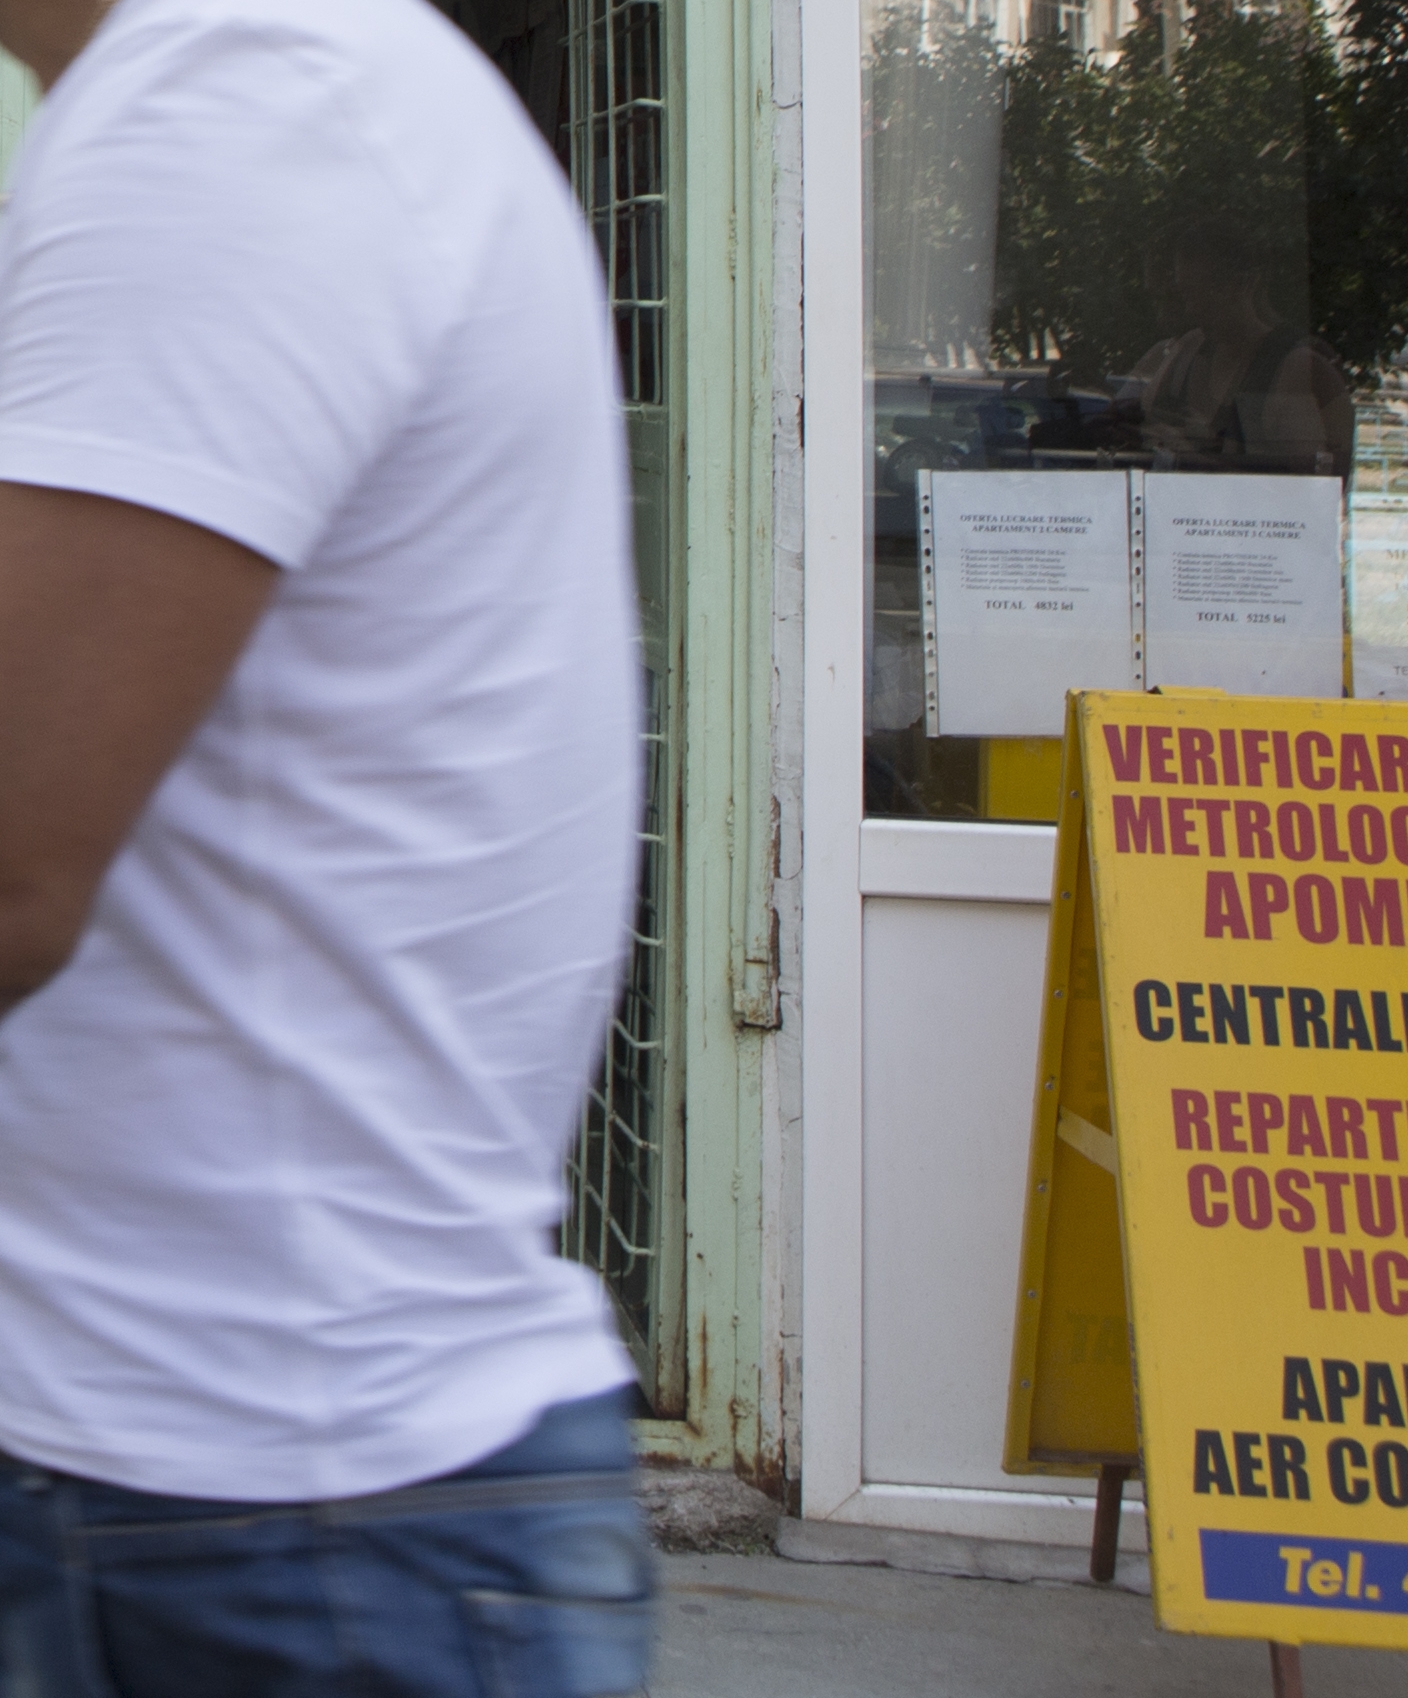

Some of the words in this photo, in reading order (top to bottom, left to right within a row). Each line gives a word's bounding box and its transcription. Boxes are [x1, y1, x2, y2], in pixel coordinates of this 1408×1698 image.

[960, 515, 997, 523] OFERTA
[1000, 515, 1045, 523] LUCRARE
[1048, 516, 1093, 524] TERMICA
[972, 525, 1036, 533] APARTAMENT
[1046, 526, 1088, 534] CAMERE
[1172, 518, 1211, 526] OFERTA
[1261, 521, 1306, 530] TERMICA
[985, 601, 1026, 610] TOTAL
[1034, 602, 1058, 610] 4832
[1061, 602, 1073, 611] lei
[1197, 612, 1238, 622] TOTAL
[1247, 613, 1271, 623] 5225
[1273, 614, 1286, 624] lei
[1204, 870, 1408, 947] APOM
[1133, 979, 1408, 1052] CENTRAL
[1171, 1088, 1408, 1162] REPART
[1187, 1163, 1408, 1239] COSTU
[1303, 1246, 1408, 1317] INC
[1282, 1356, 1408, 1428] APA
[1193, 1428, 1311, 1501] AER
[1326, 1437, 1408, 1509] CO
[1279, 1546, 1381, 1600] Tel.
